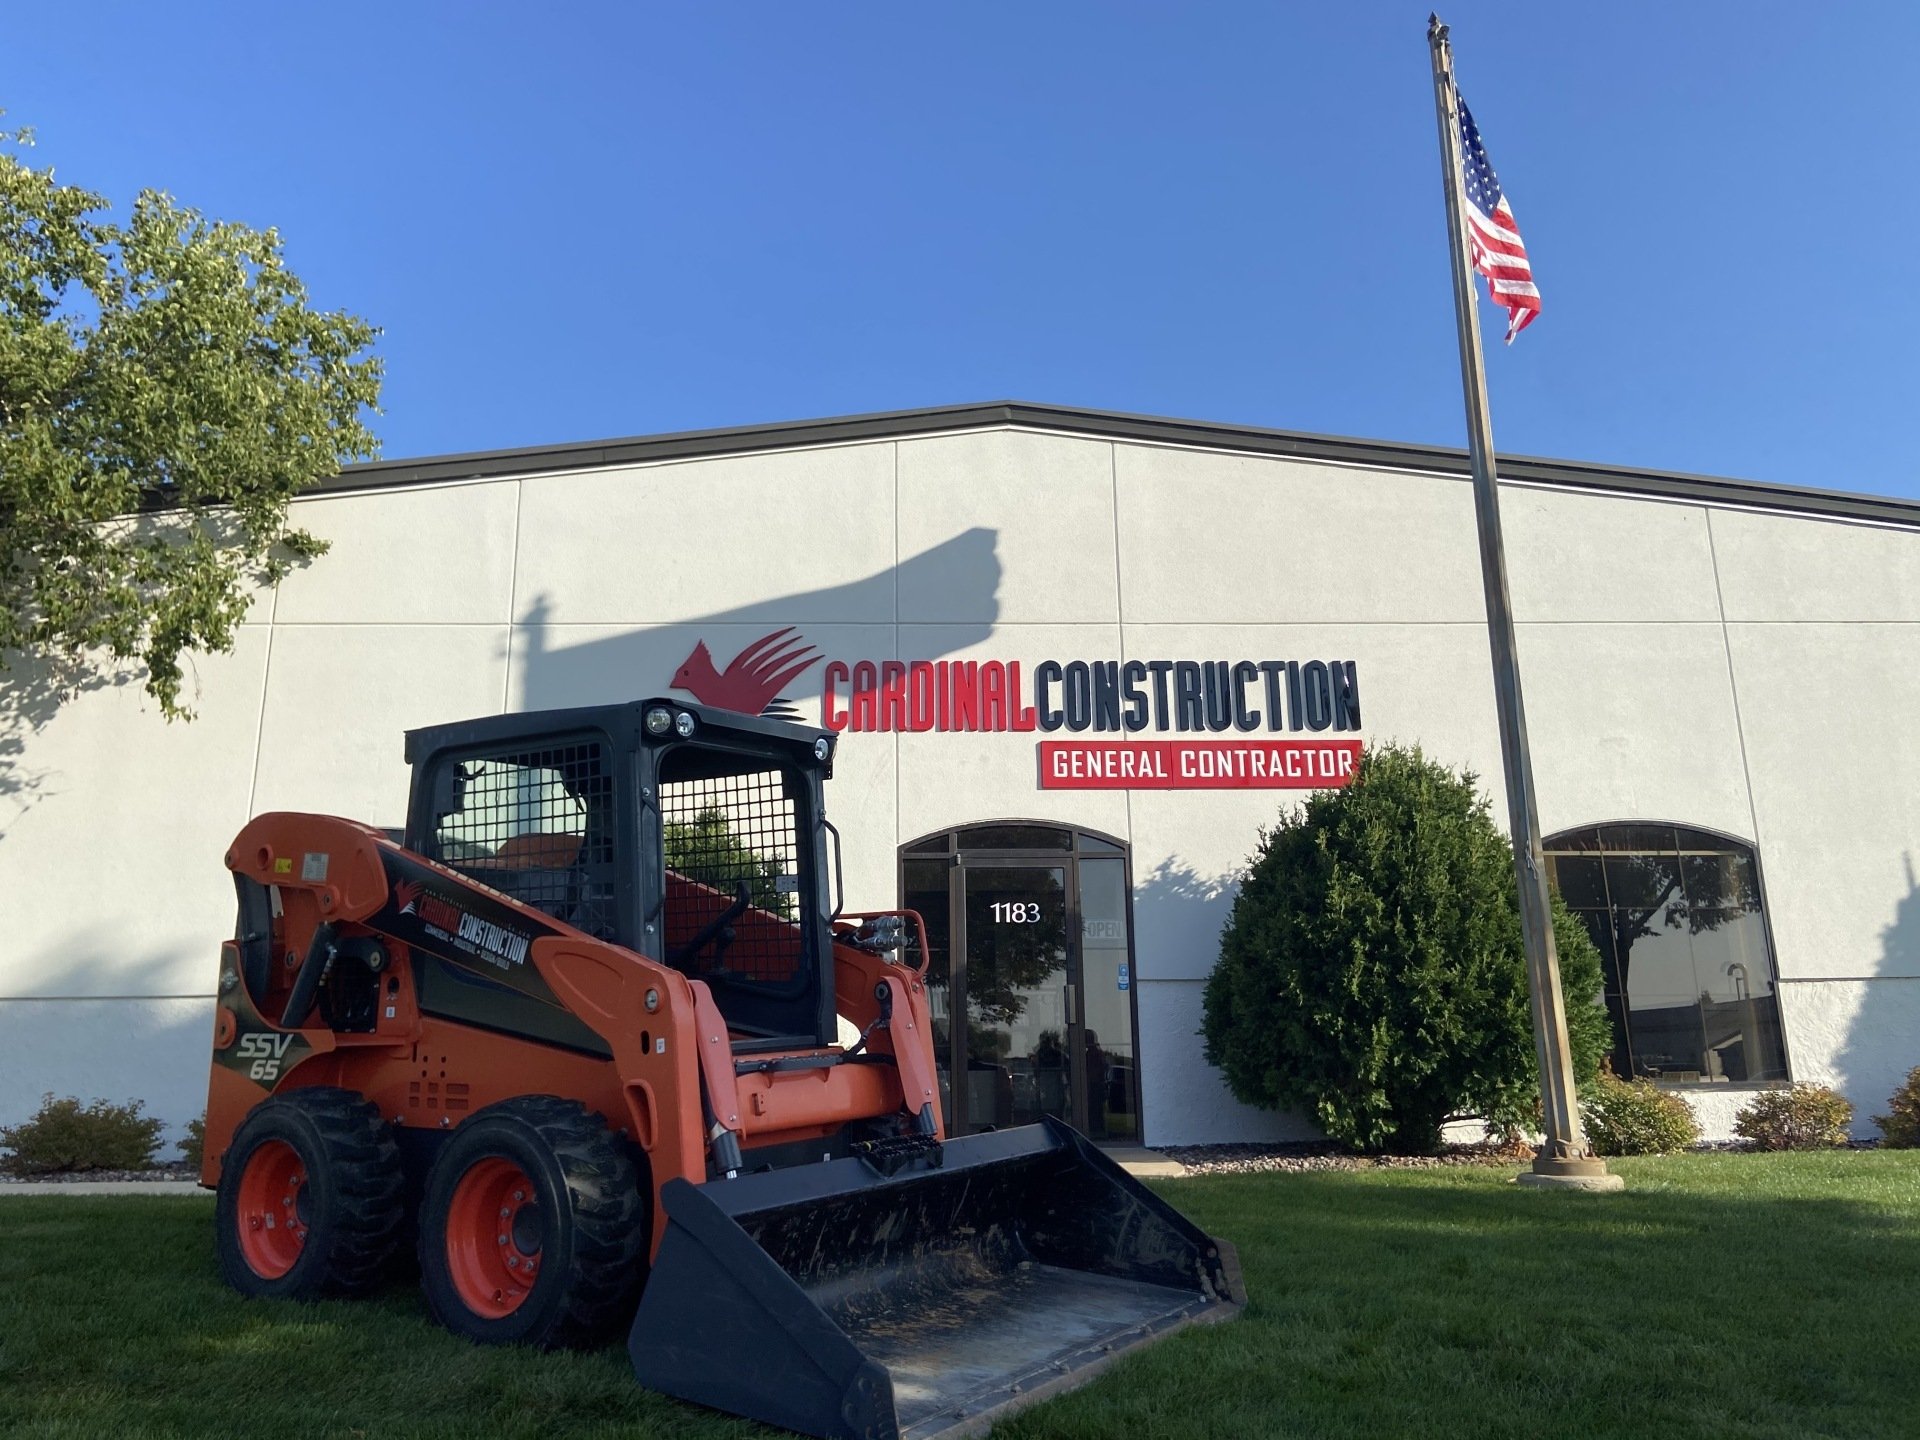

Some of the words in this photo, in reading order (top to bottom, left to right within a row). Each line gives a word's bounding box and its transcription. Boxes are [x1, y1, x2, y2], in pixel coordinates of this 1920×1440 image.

[822, 660, 1036, 732] CARDINAL
[1035, 660, 1362, 732] CONSTRUCTION
[1053, 749, 1168, 778] GENERAL
[1181, 749, 1353, 777] CONTRACTOR
[990, 902, 1041, 923] 1183
[458, 911, 529, 965] CONSTRUCTION
[1087, 920, 1122, 938] OPEN
[236, 1032, 295, 1058] SSV
[250, 1059, 281, 1080] 65
